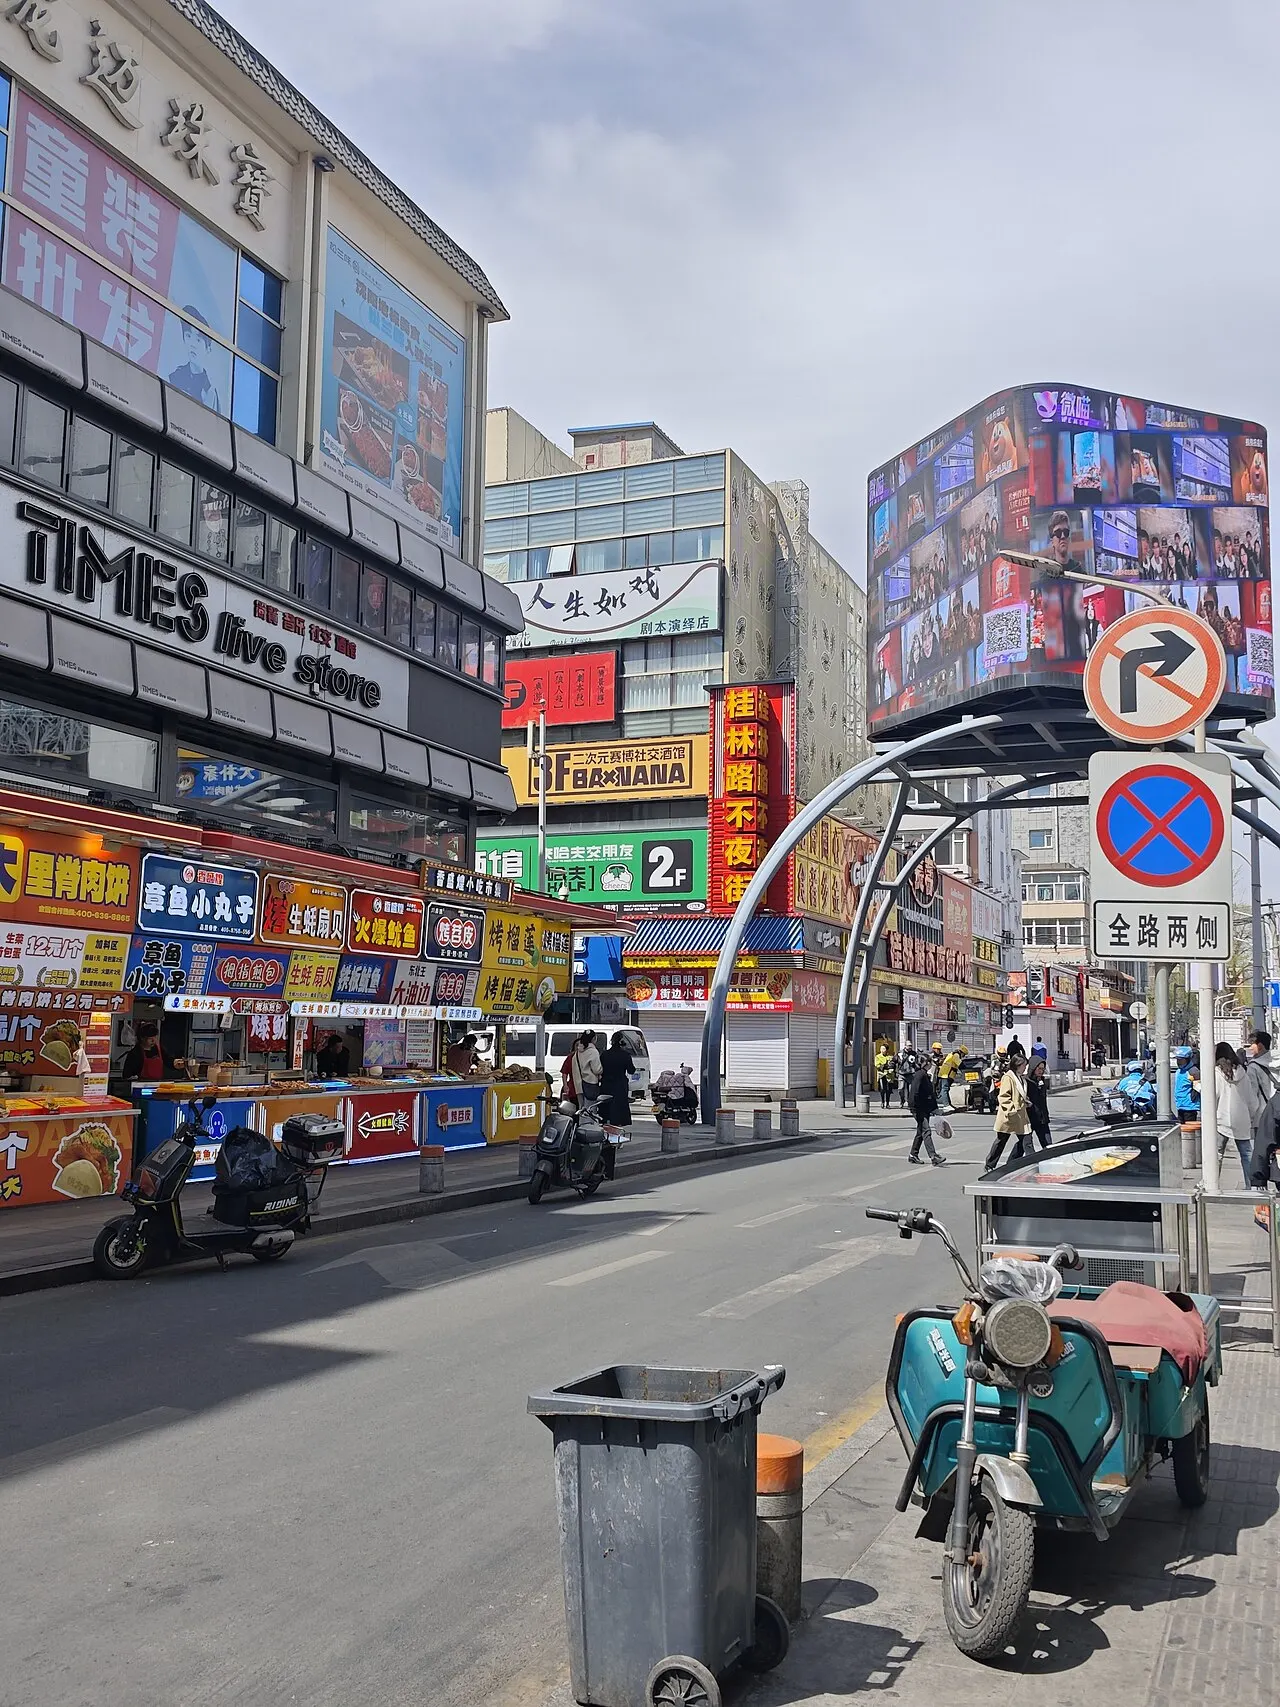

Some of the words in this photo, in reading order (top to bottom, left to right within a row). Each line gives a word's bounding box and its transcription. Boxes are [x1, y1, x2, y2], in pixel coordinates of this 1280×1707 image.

[22, 111, 161, 281] 童装
[1061, 391, 1091, 418] 微喵
[18, 501, 210, 642] TIMES
[215, 612, 287, 673] live
[296, 654, 382, 708] store
[526, 566, 661, 622] 人生如戏
[640, 616, 710, 635] 剧本演绎店
[573, 746, 686, 766] 二次元赛博社交酒馆
[25, 849, 131, 907] 里脊肉饼
[648, 845, 687, 888] 2F
[143, 881, 254, 924] 章鱼小丸子
[355, 917, 416, 949] 火爆鱿鱼
[438, 918, 476, 947] 烤苕皮
[488, 919, 537, 953] 烤榴莲
[1108, 912, 1218, 950] 全路两侧
[25, 935, 85, 958] 12元/个
[143, 940, 183, 968] 章鱼
[127, 966, 187, 995] 小丸子
[289, 964, 335, 988] 生蚝扇贝
[408, 964, 427, 977] 东北王
[660, 974, 705, 986] 韩国明洞
[391, 979, 432, 1005] 大油边
[484, 975, 530, 1002] 烤榴莲
[660, 987, 705, 1000] 街边小吃
[264, 1196, 298, 1211] RIDING
